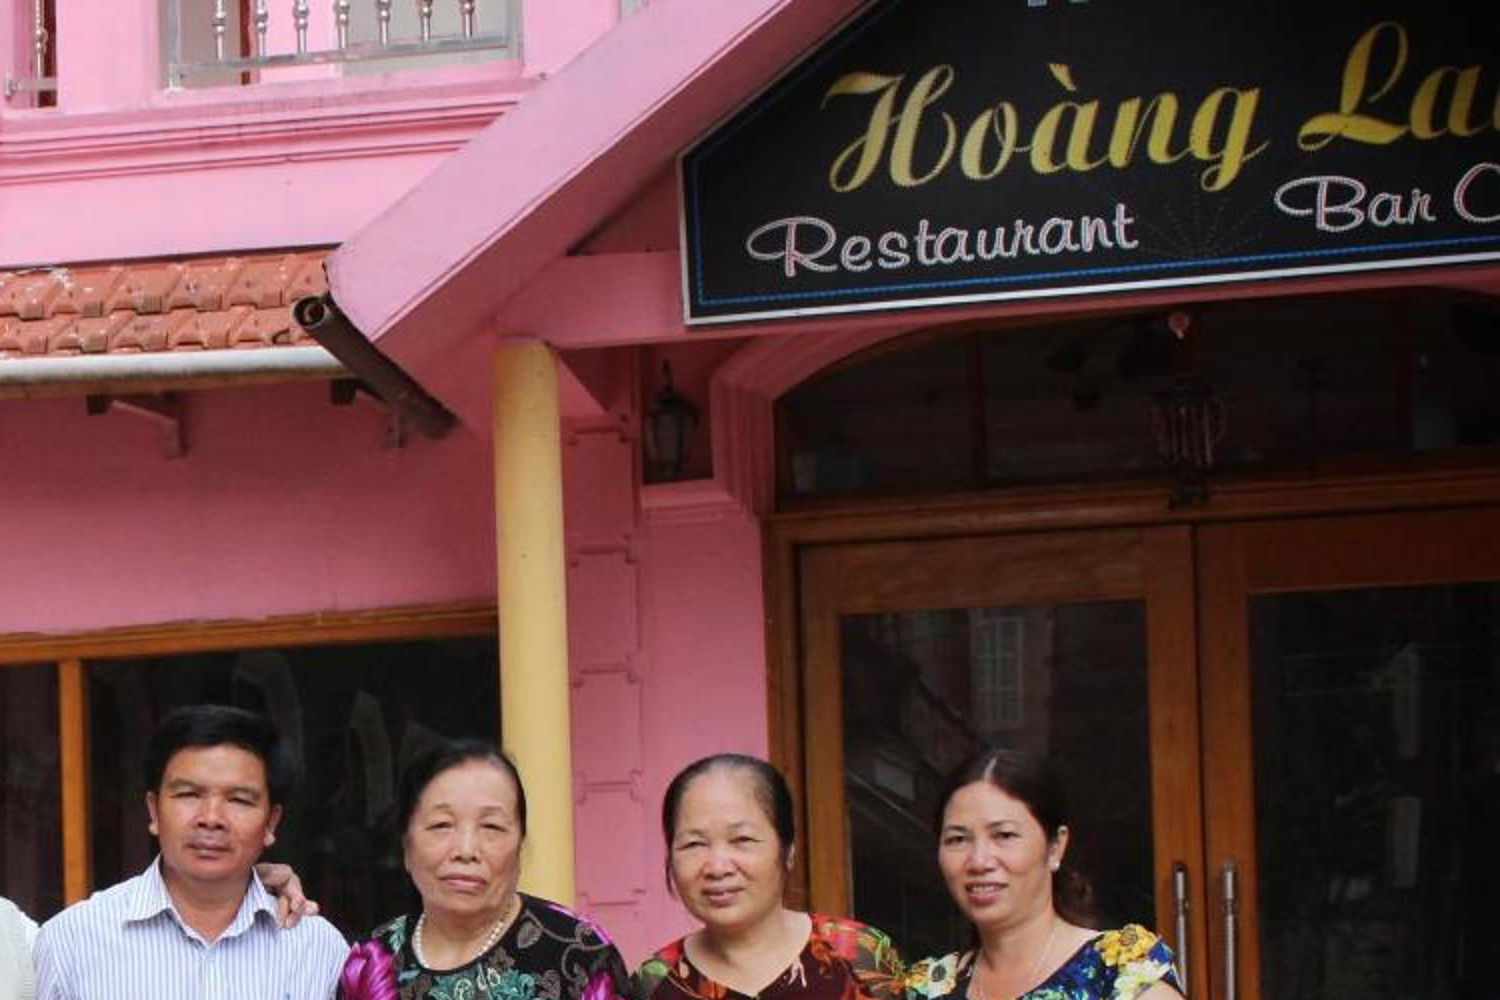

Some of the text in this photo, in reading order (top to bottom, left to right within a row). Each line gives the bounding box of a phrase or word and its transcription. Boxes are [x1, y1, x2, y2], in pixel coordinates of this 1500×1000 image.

[820, 20, 1500, 192] Hoàng La
[746, 203, 1139, 277] Restaurant
[1275, 175, 1437, 233] Bar
